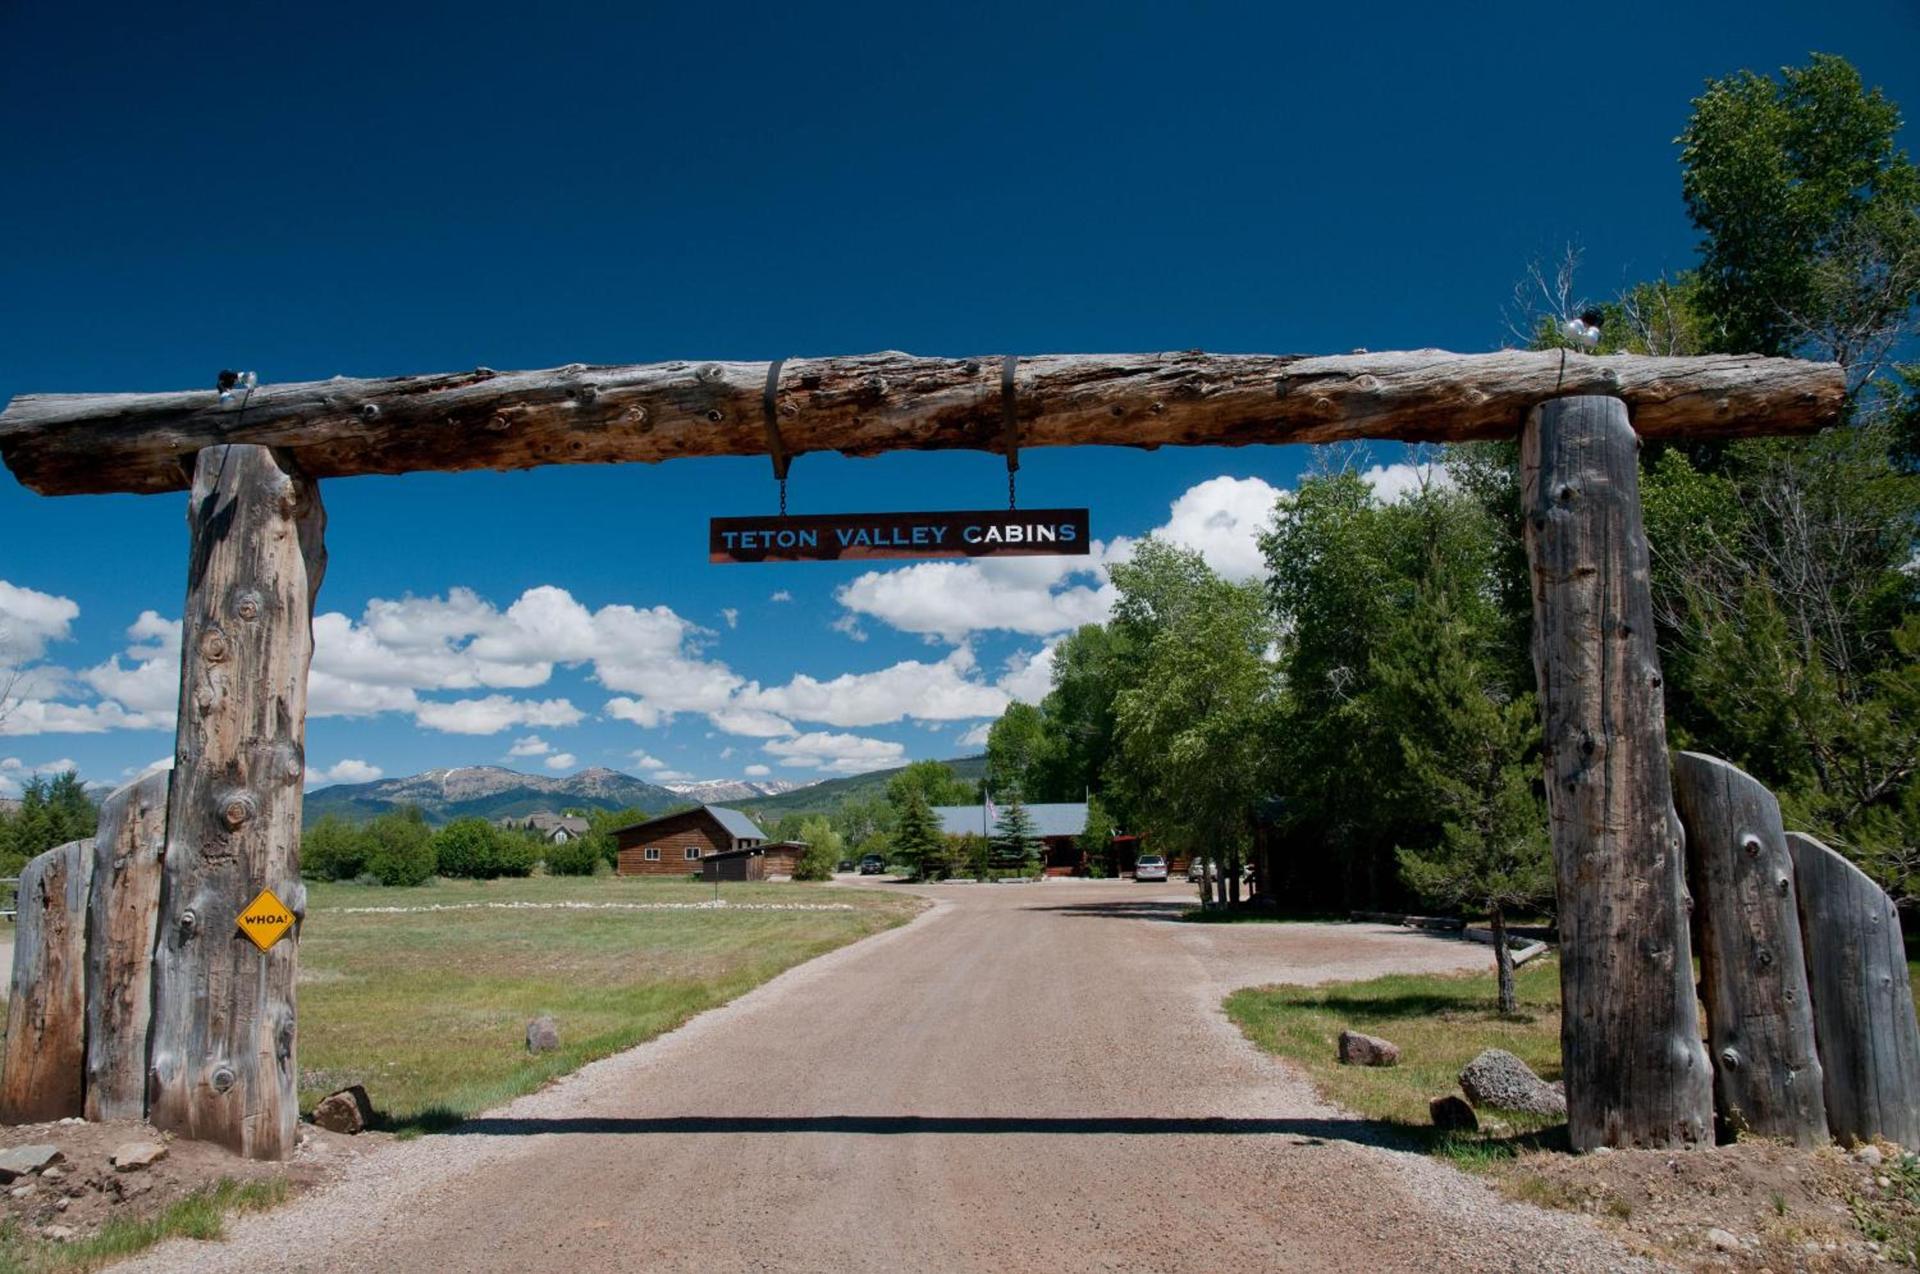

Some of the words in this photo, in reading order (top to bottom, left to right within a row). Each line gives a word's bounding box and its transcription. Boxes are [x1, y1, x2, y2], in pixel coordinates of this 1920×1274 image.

[722, 528, 818, 549] TETON
[836, 526, 948, 546] VALLEY
[962, 524, 1076, 543] CABINS
[245, 914, 288, 925] WHOA!
